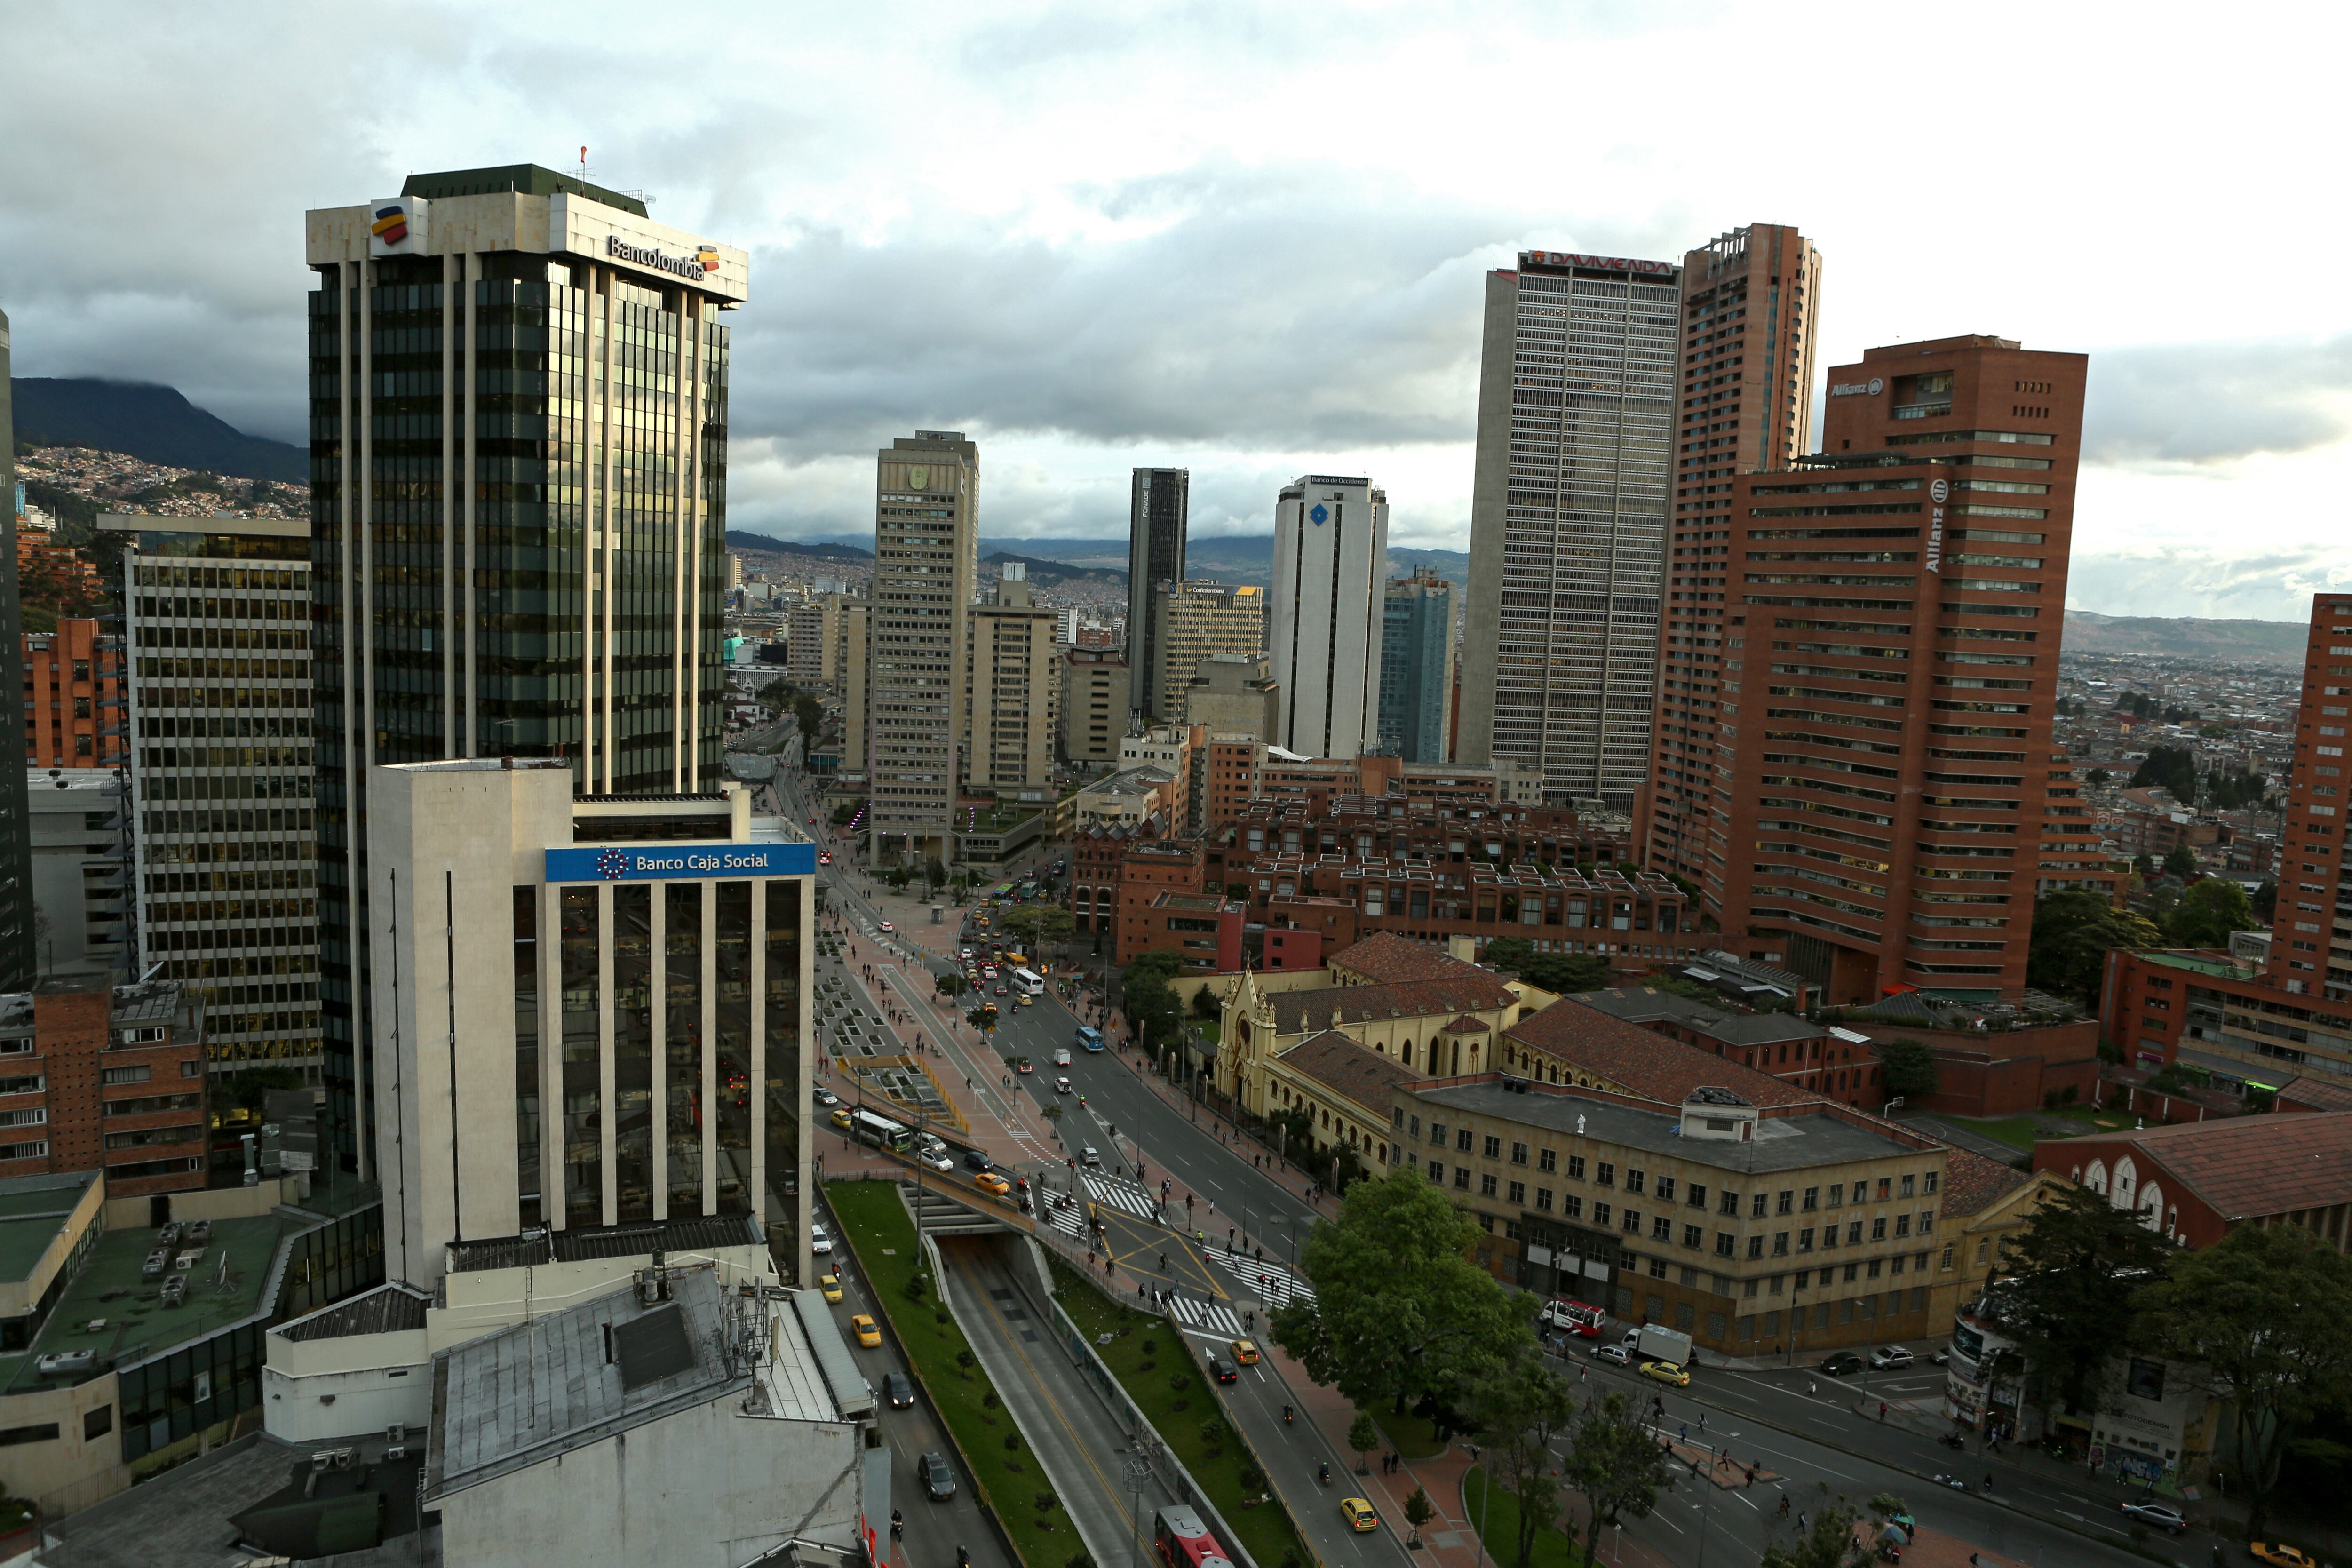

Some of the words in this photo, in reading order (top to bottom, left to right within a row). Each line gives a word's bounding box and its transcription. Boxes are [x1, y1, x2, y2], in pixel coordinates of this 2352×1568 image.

[609, 235, 705, 281] Bancolombia
[1551, 253, 1670, 274] DAVIVIENDA
[1832, 384, 1867, 396] Allianz
[1926, 508, 1944, 573] Allianz
[636, 856, 683, 871] Banco
[687, 854, 720, 872] Caja
[723, 852, 769, 868] Social
[2123, 1413, 2169, 1430] FOTODESIGN
